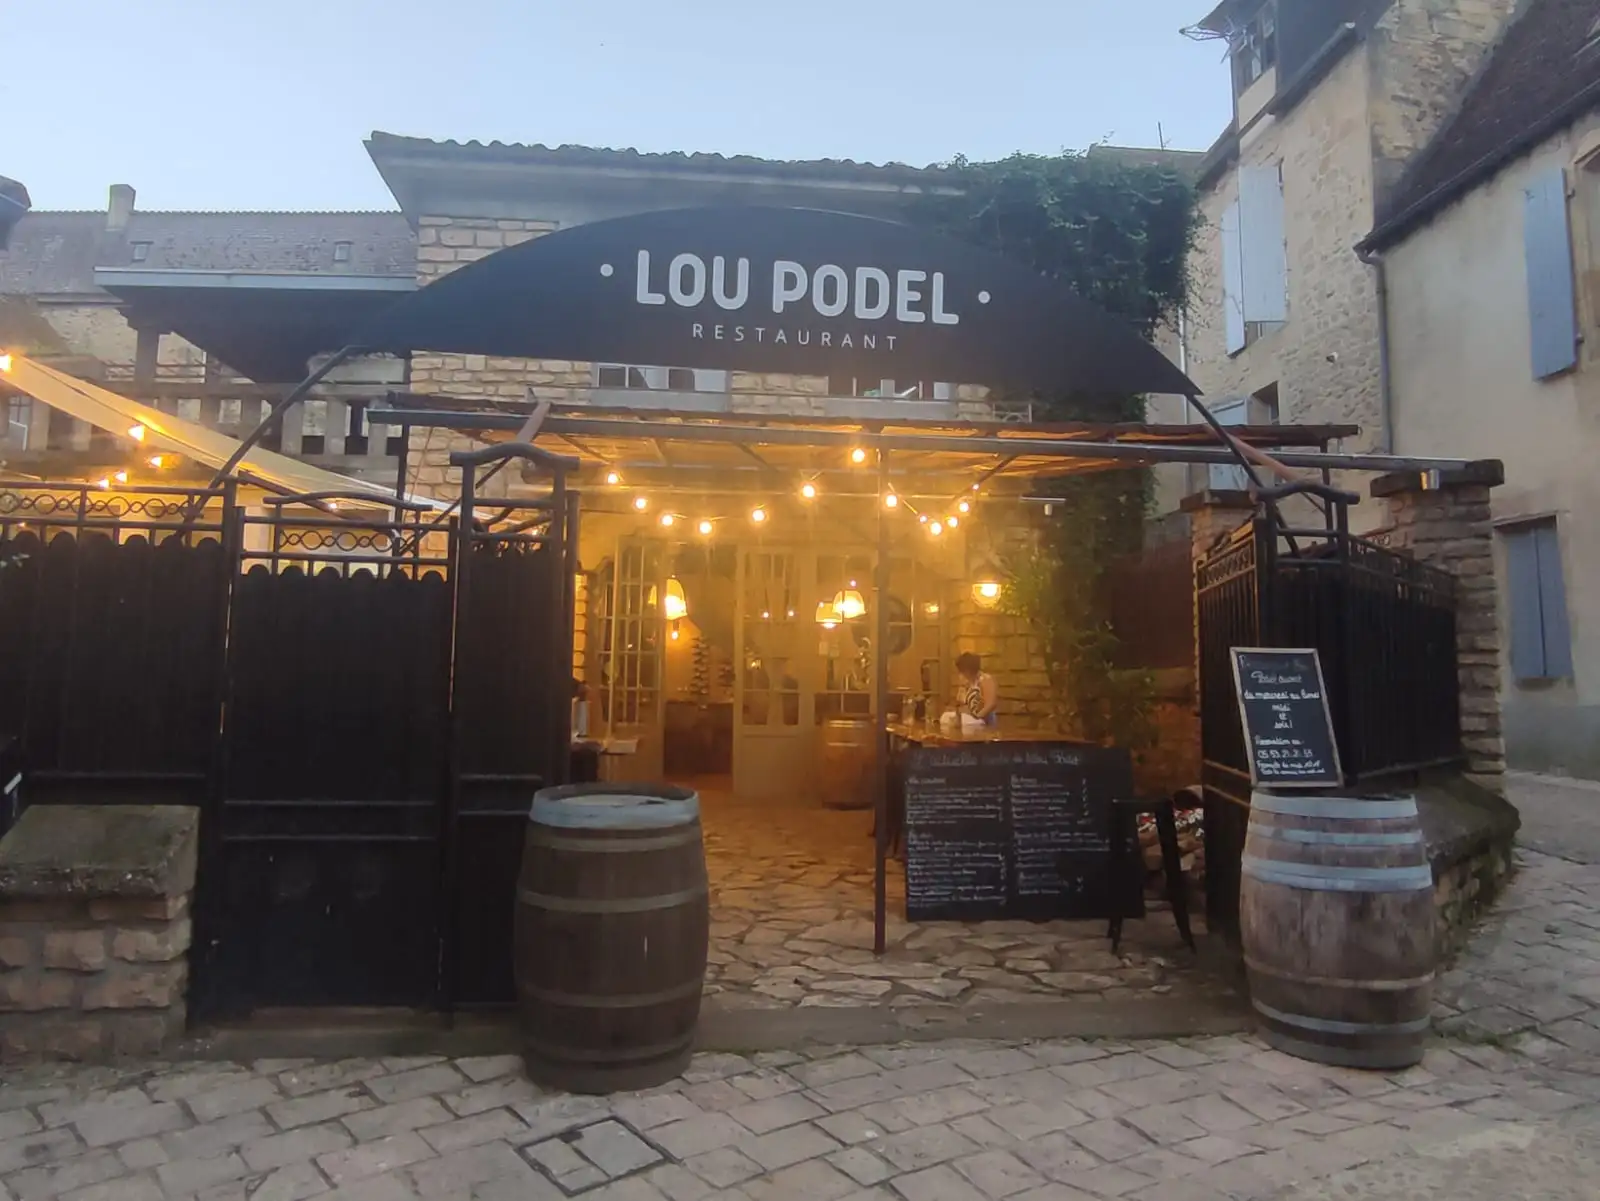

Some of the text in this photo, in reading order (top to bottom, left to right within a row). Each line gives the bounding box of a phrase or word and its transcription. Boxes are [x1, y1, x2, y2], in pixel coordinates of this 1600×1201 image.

[637, 250, 959, 324] LOU PODEL
[692, 322, 897, 351] RESTAURANT
